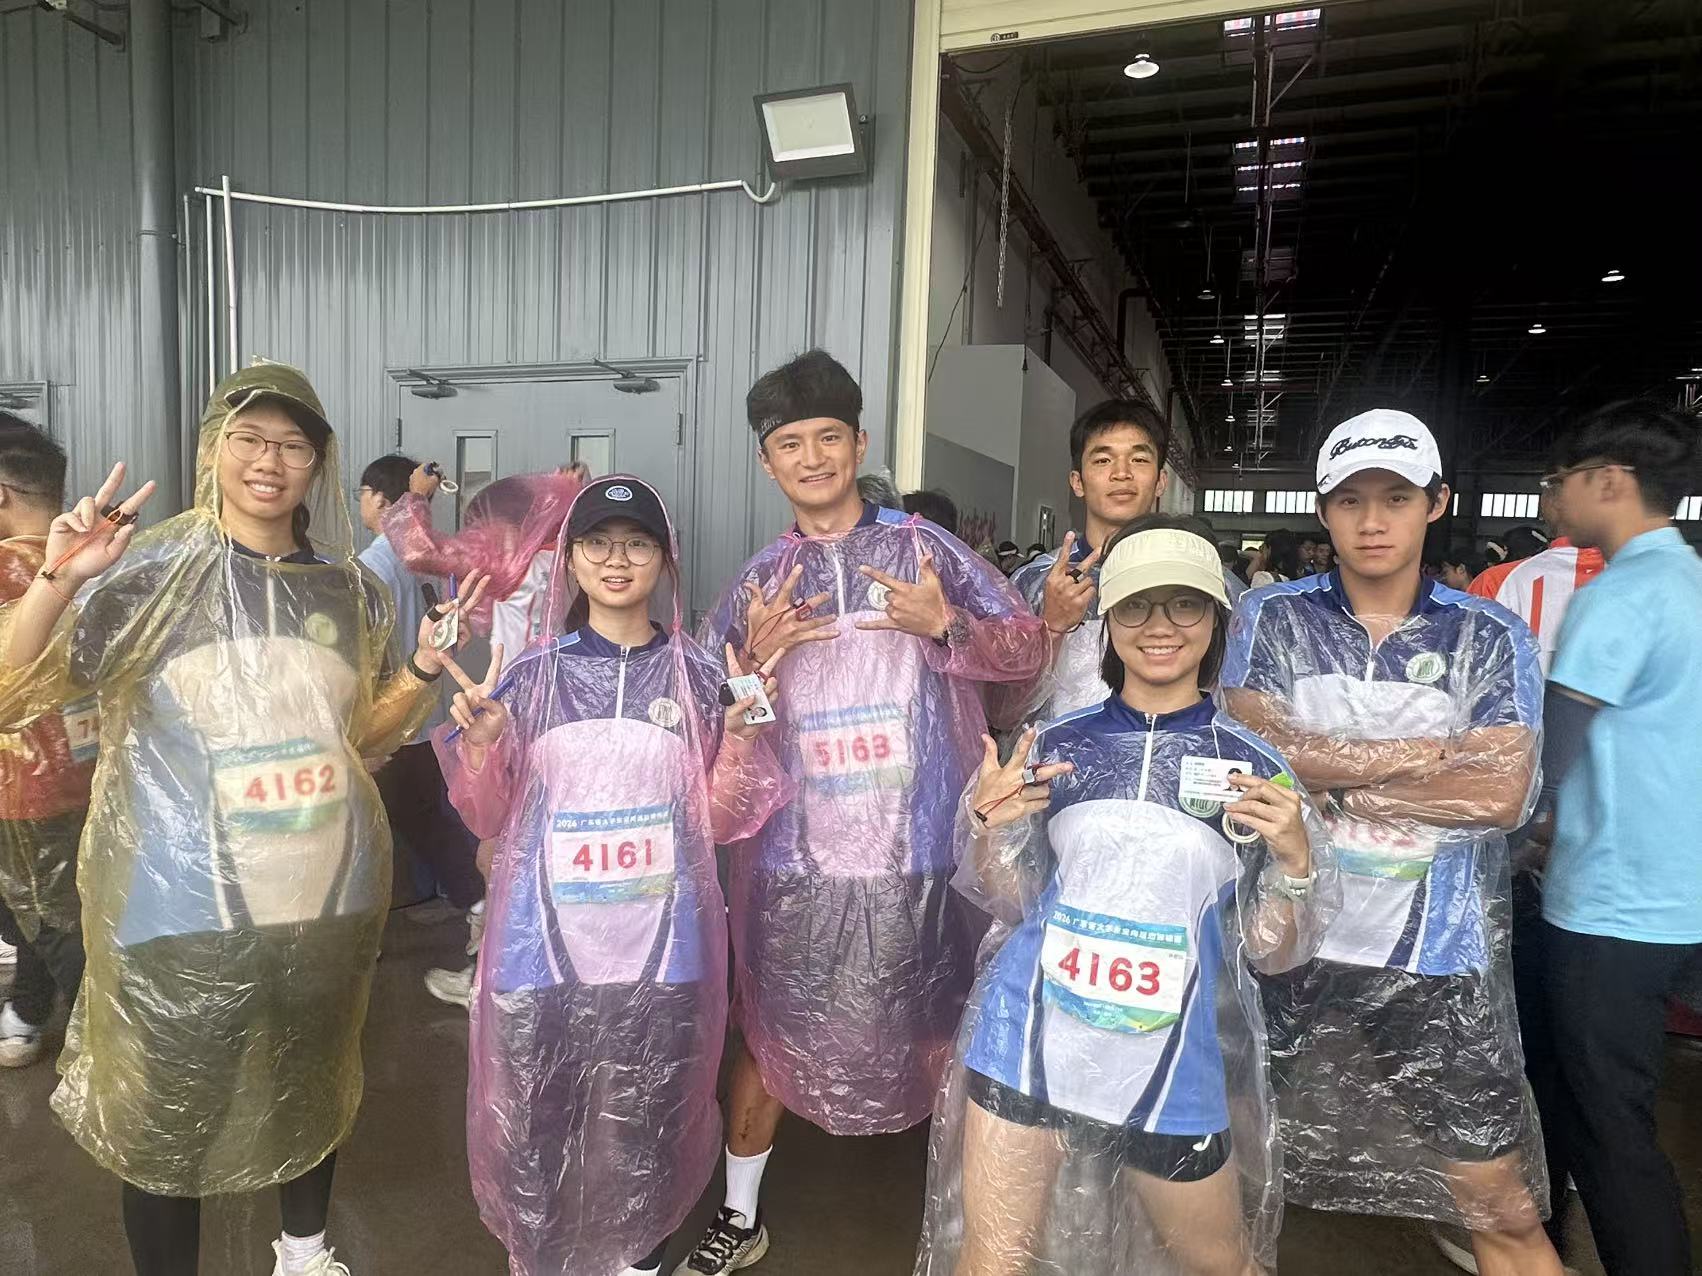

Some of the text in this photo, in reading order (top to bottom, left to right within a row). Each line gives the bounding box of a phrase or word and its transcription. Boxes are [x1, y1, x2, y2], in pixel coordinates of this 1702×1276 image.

[815, 734, 890, 767] 5163
[244, 764, 336, 802] 4162
[572, 838, 652, 872] 4161
[1058, 947, 1161, 996] 4163
